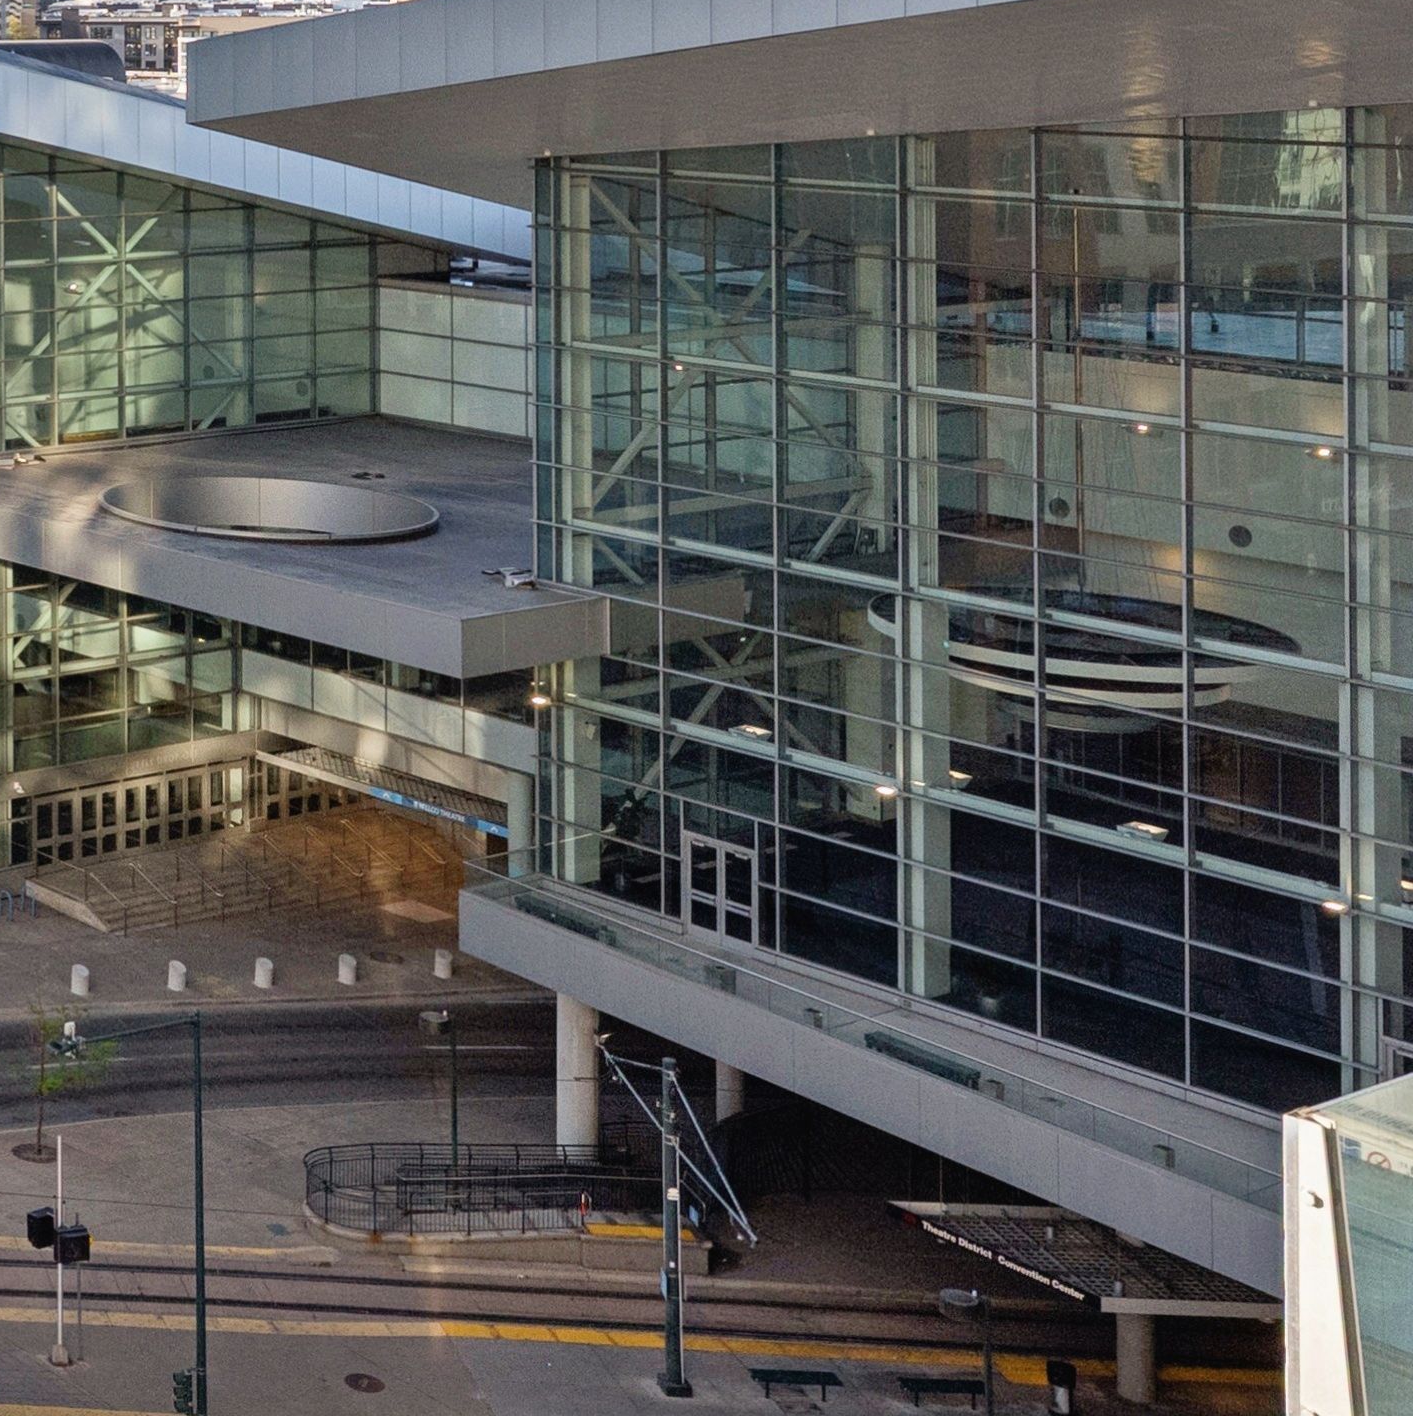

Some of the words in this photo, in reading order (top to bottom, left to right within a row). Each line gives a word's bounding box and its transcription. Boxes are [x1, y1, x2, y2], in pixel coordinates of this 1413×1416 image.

[921, 1220, 957, 1243] Theatre
[957, 1238, 993, 1261] District
[997, 1255, 1050, 1286] Convention
[1051, 1278, 1086, 1302] Center
